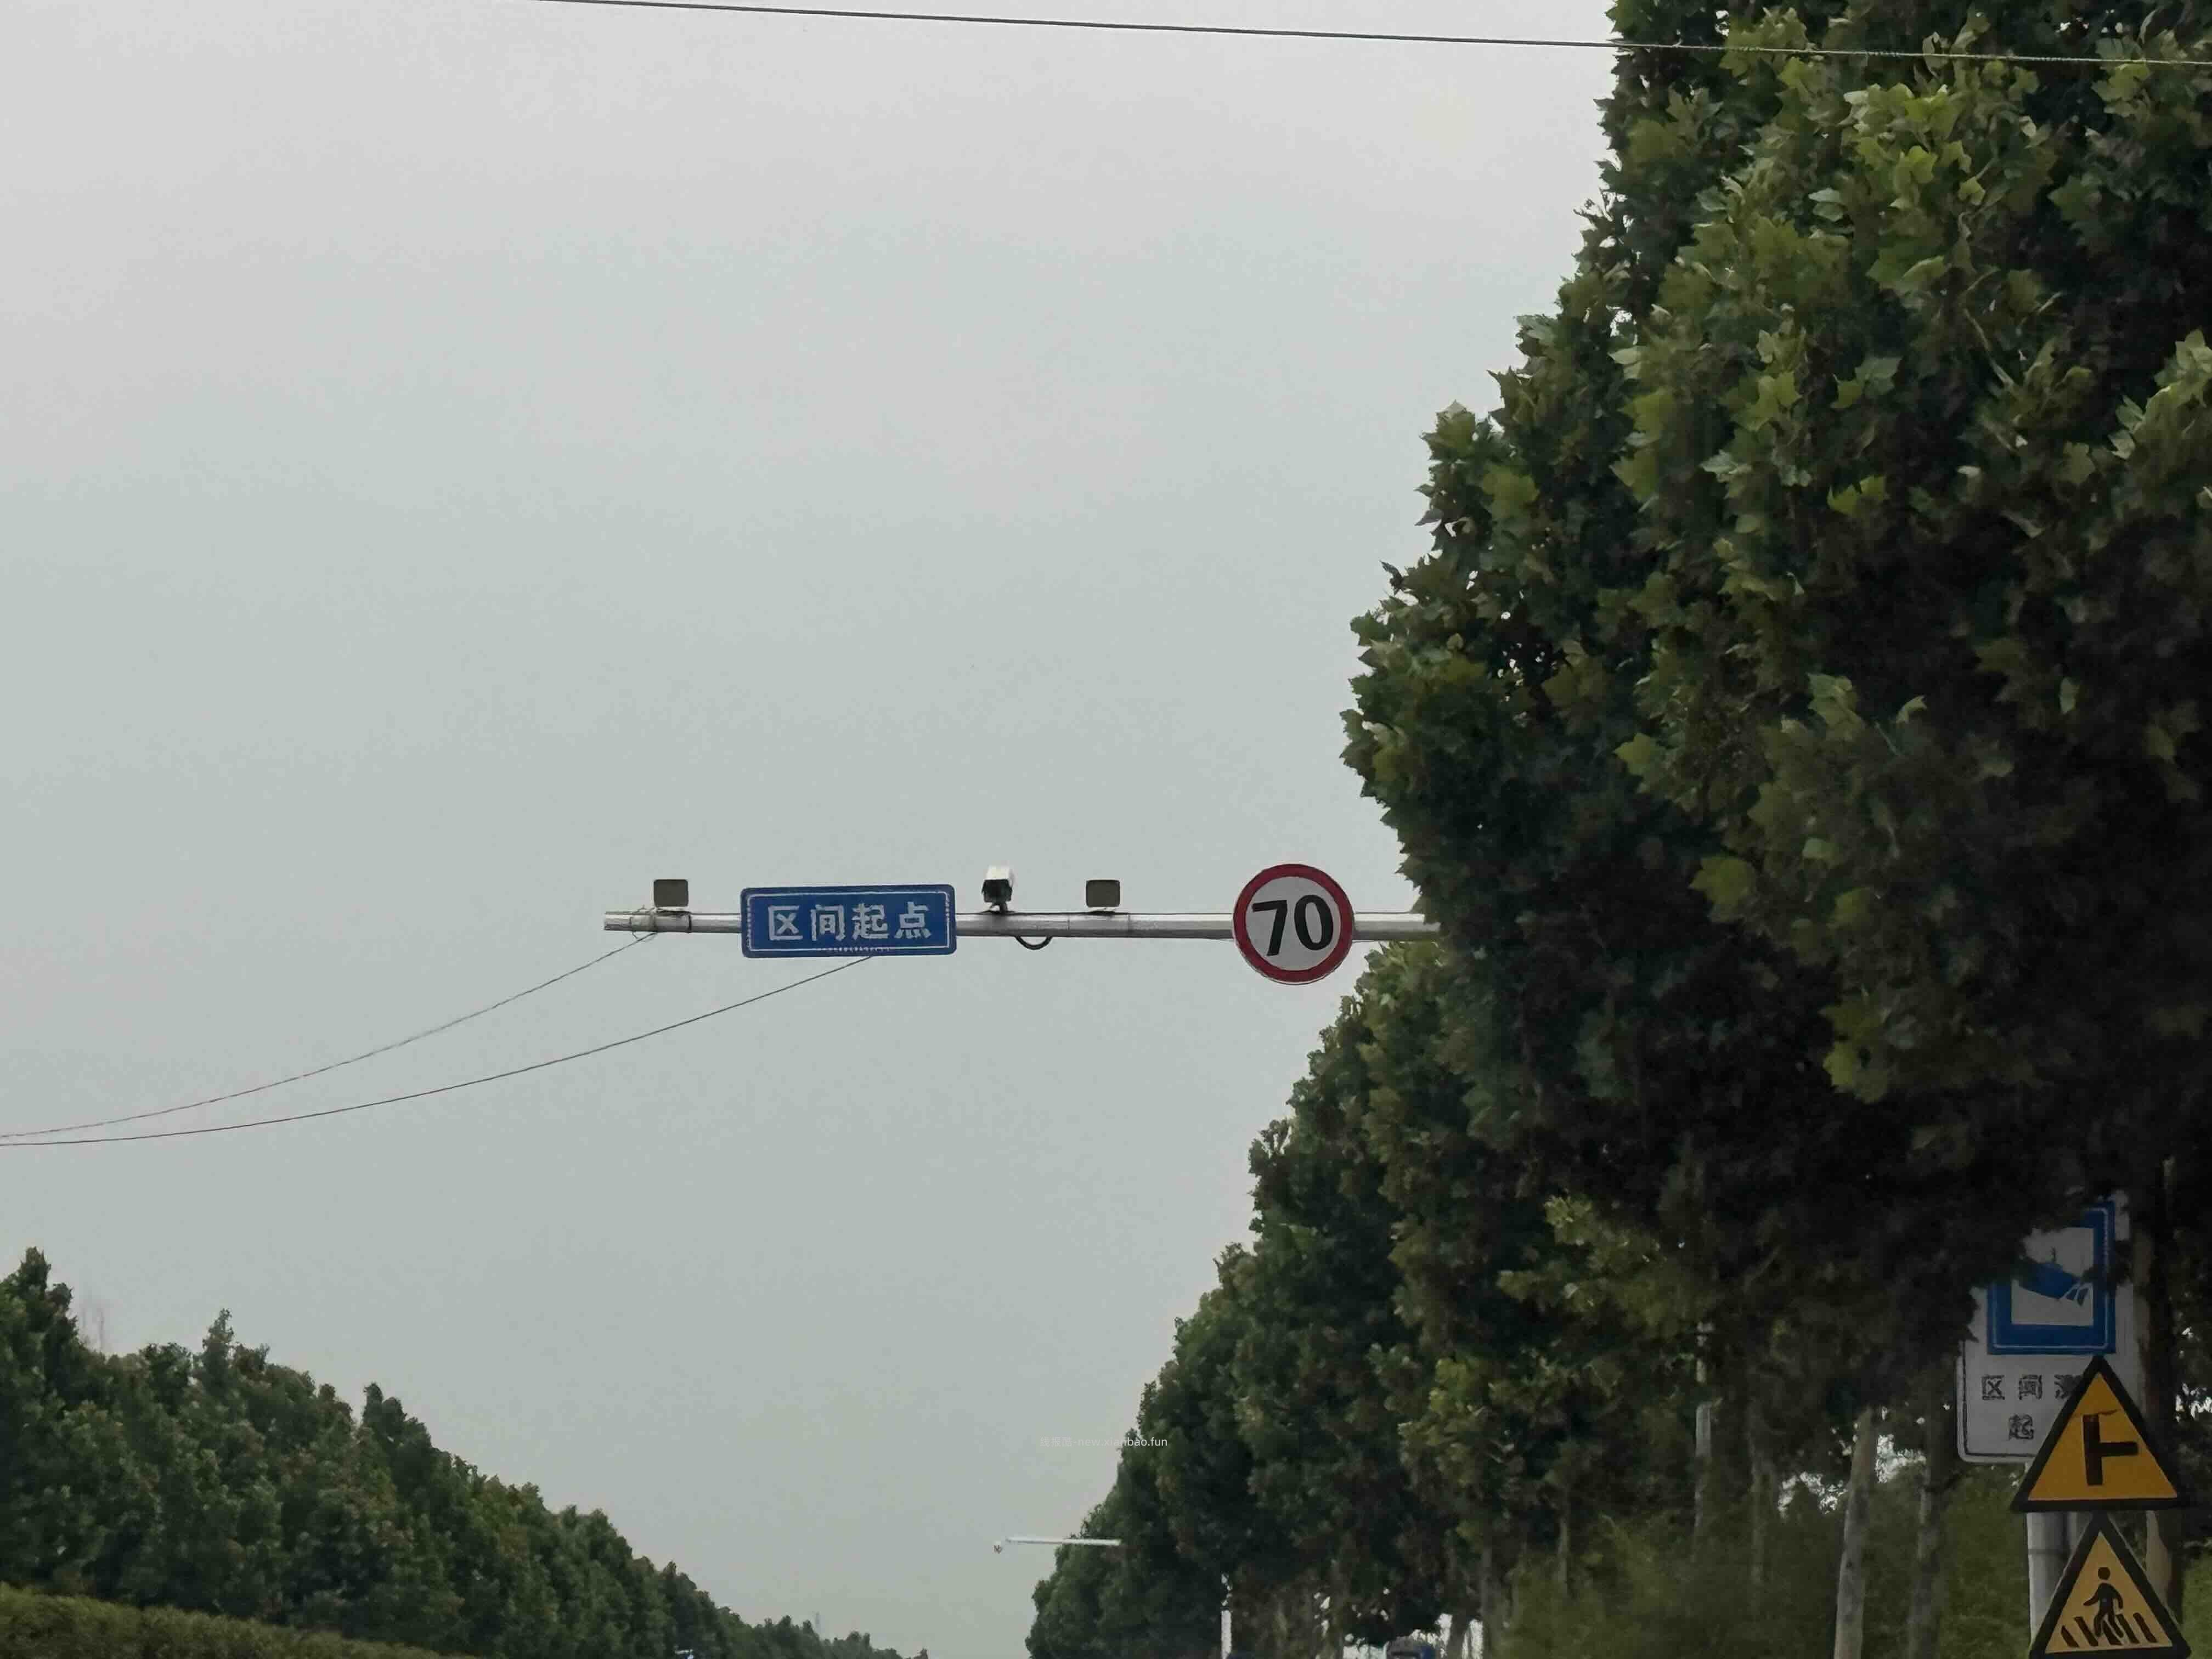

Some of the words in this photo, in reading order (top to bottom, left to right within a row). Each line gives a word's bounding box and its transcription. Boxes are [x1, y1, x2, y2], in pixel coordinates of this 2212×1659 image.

[768, 901, 932, 941] 区间起点
[1251, 895, 1334, 956] 70
